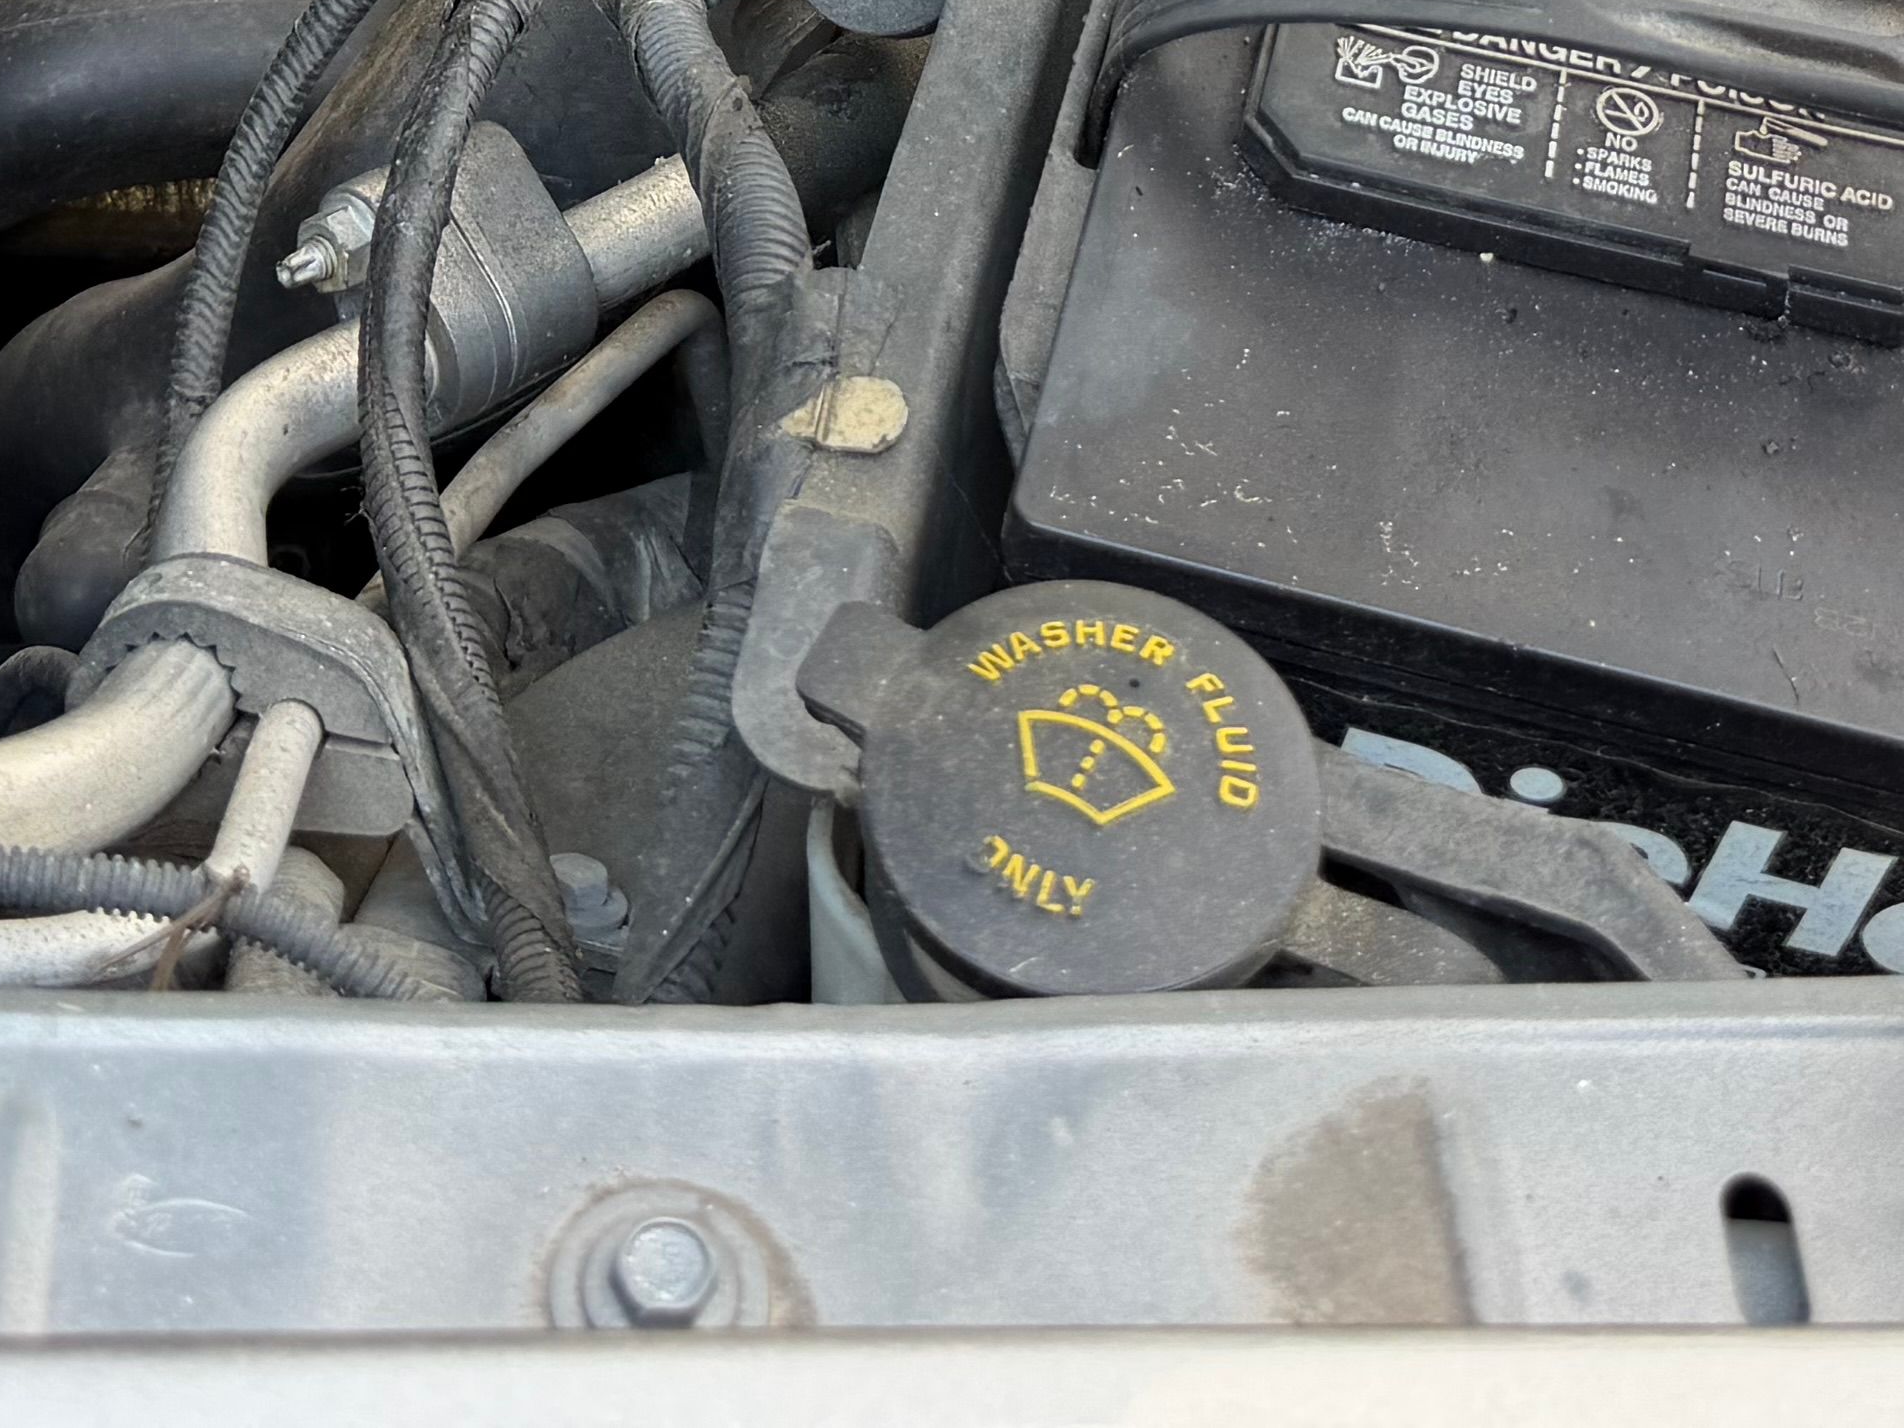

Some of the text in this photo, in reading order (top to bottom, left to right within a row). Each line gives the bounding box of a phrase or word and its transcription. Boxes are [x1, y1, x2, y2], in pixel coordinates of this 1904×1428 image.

[1458, 80, 1514, 104] EYES
[1460, 63, 1537, 92] SHIELD
[1401, 102, 1474, 131] GASES
[1404, 85, 1522, 124] EXPLOSIVE
[1342, 107, 1525, 160] CAN CAUSE BLINDNESS
[1605, 132, 1638, 152] NO
[1393, 134, 1480, 165] OR INJURY
[1586, 147, 1653, 172] SPARKS
[1584, 161, 1650, 186] FLAMES
[1728, 160, 1893, 211] SULFURIC ACID
[1582, 175, 1657, 204] SMOKING
[1725, 177, 1825, 211] CAN CAUSE
[1723, 207, 1849, 247] SEVERE BURNS
[1725, 192, 1849, 232] BLINDNESS OR
[966, 619, 1259, 809] WASHER FLUID
